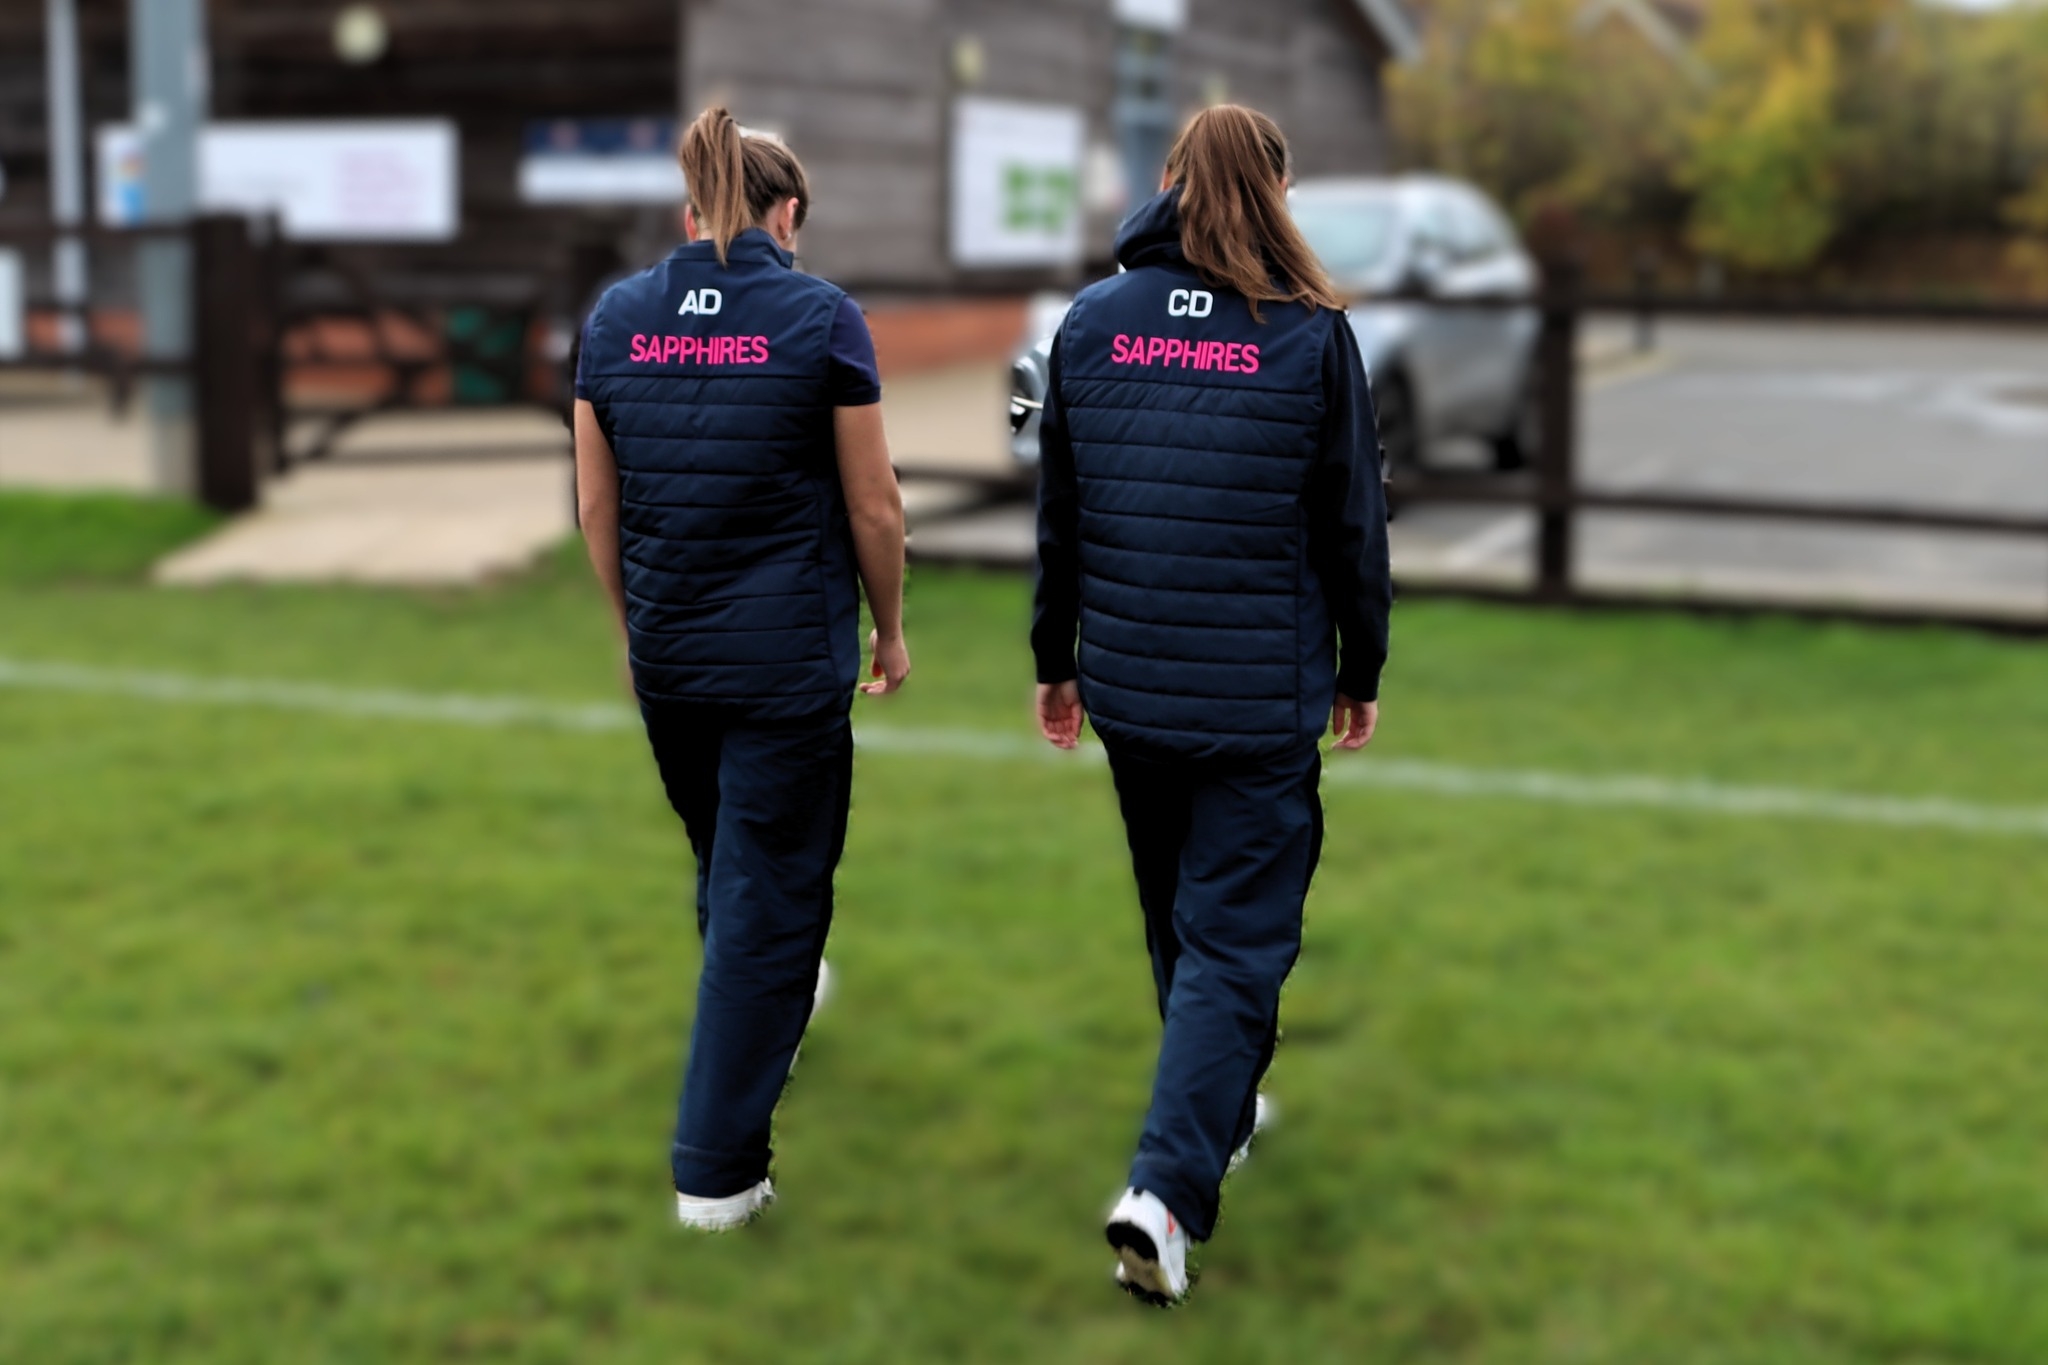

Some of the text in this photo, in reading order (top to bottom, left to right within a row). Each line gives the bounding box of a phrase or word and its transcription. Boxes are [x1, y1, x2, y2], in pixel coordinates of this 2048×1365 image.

[678, 289, 722, 315] AD
[1168, 289, 1213, 318] CD
[629, 334, 769, 364] SAPPHIRES
[1111, 334, 1260, 374] SAPPHIRES
